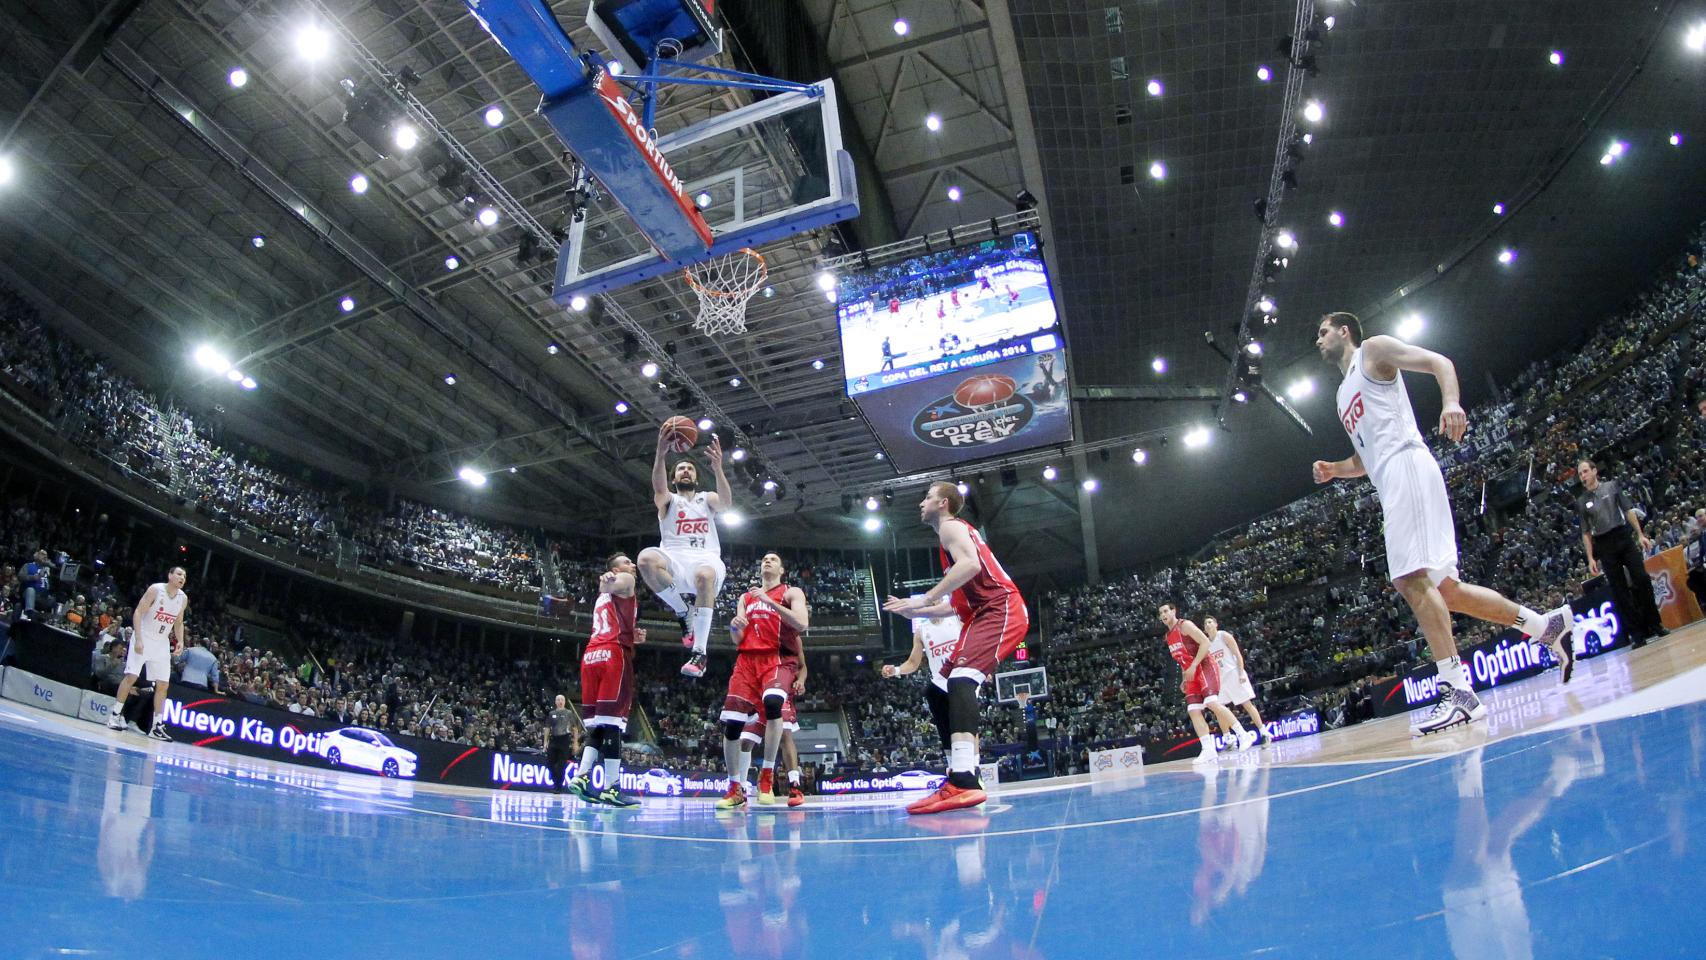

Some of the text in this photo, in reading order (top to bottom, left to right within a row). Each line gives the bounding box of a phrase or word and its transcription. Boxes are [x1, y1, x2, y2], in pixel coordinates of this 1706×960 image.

[600, 93, 685, 197] SPORTIUM
[881, 344, 1027, 384] COPA DEL REY A CORUÑA 2016
[930, 420, 992, 439] COPA
[950, 423, 1016, 446] REY
[1016, 648, 1026, 660] 10
[1403, 673, 1442, 704] Nuev
[1473, 639, 1533, 686] Optim
[34, 683, 53, 702] tve
[90, 699, 108, 716] tve
[162, 698, 322, 754] Nuevo Kia Opti
[563, 761, 579, 786] Ki
[592, 764, 644, 791] Oima
[822, 778, 892, 791] Nuevo Kia Opti
